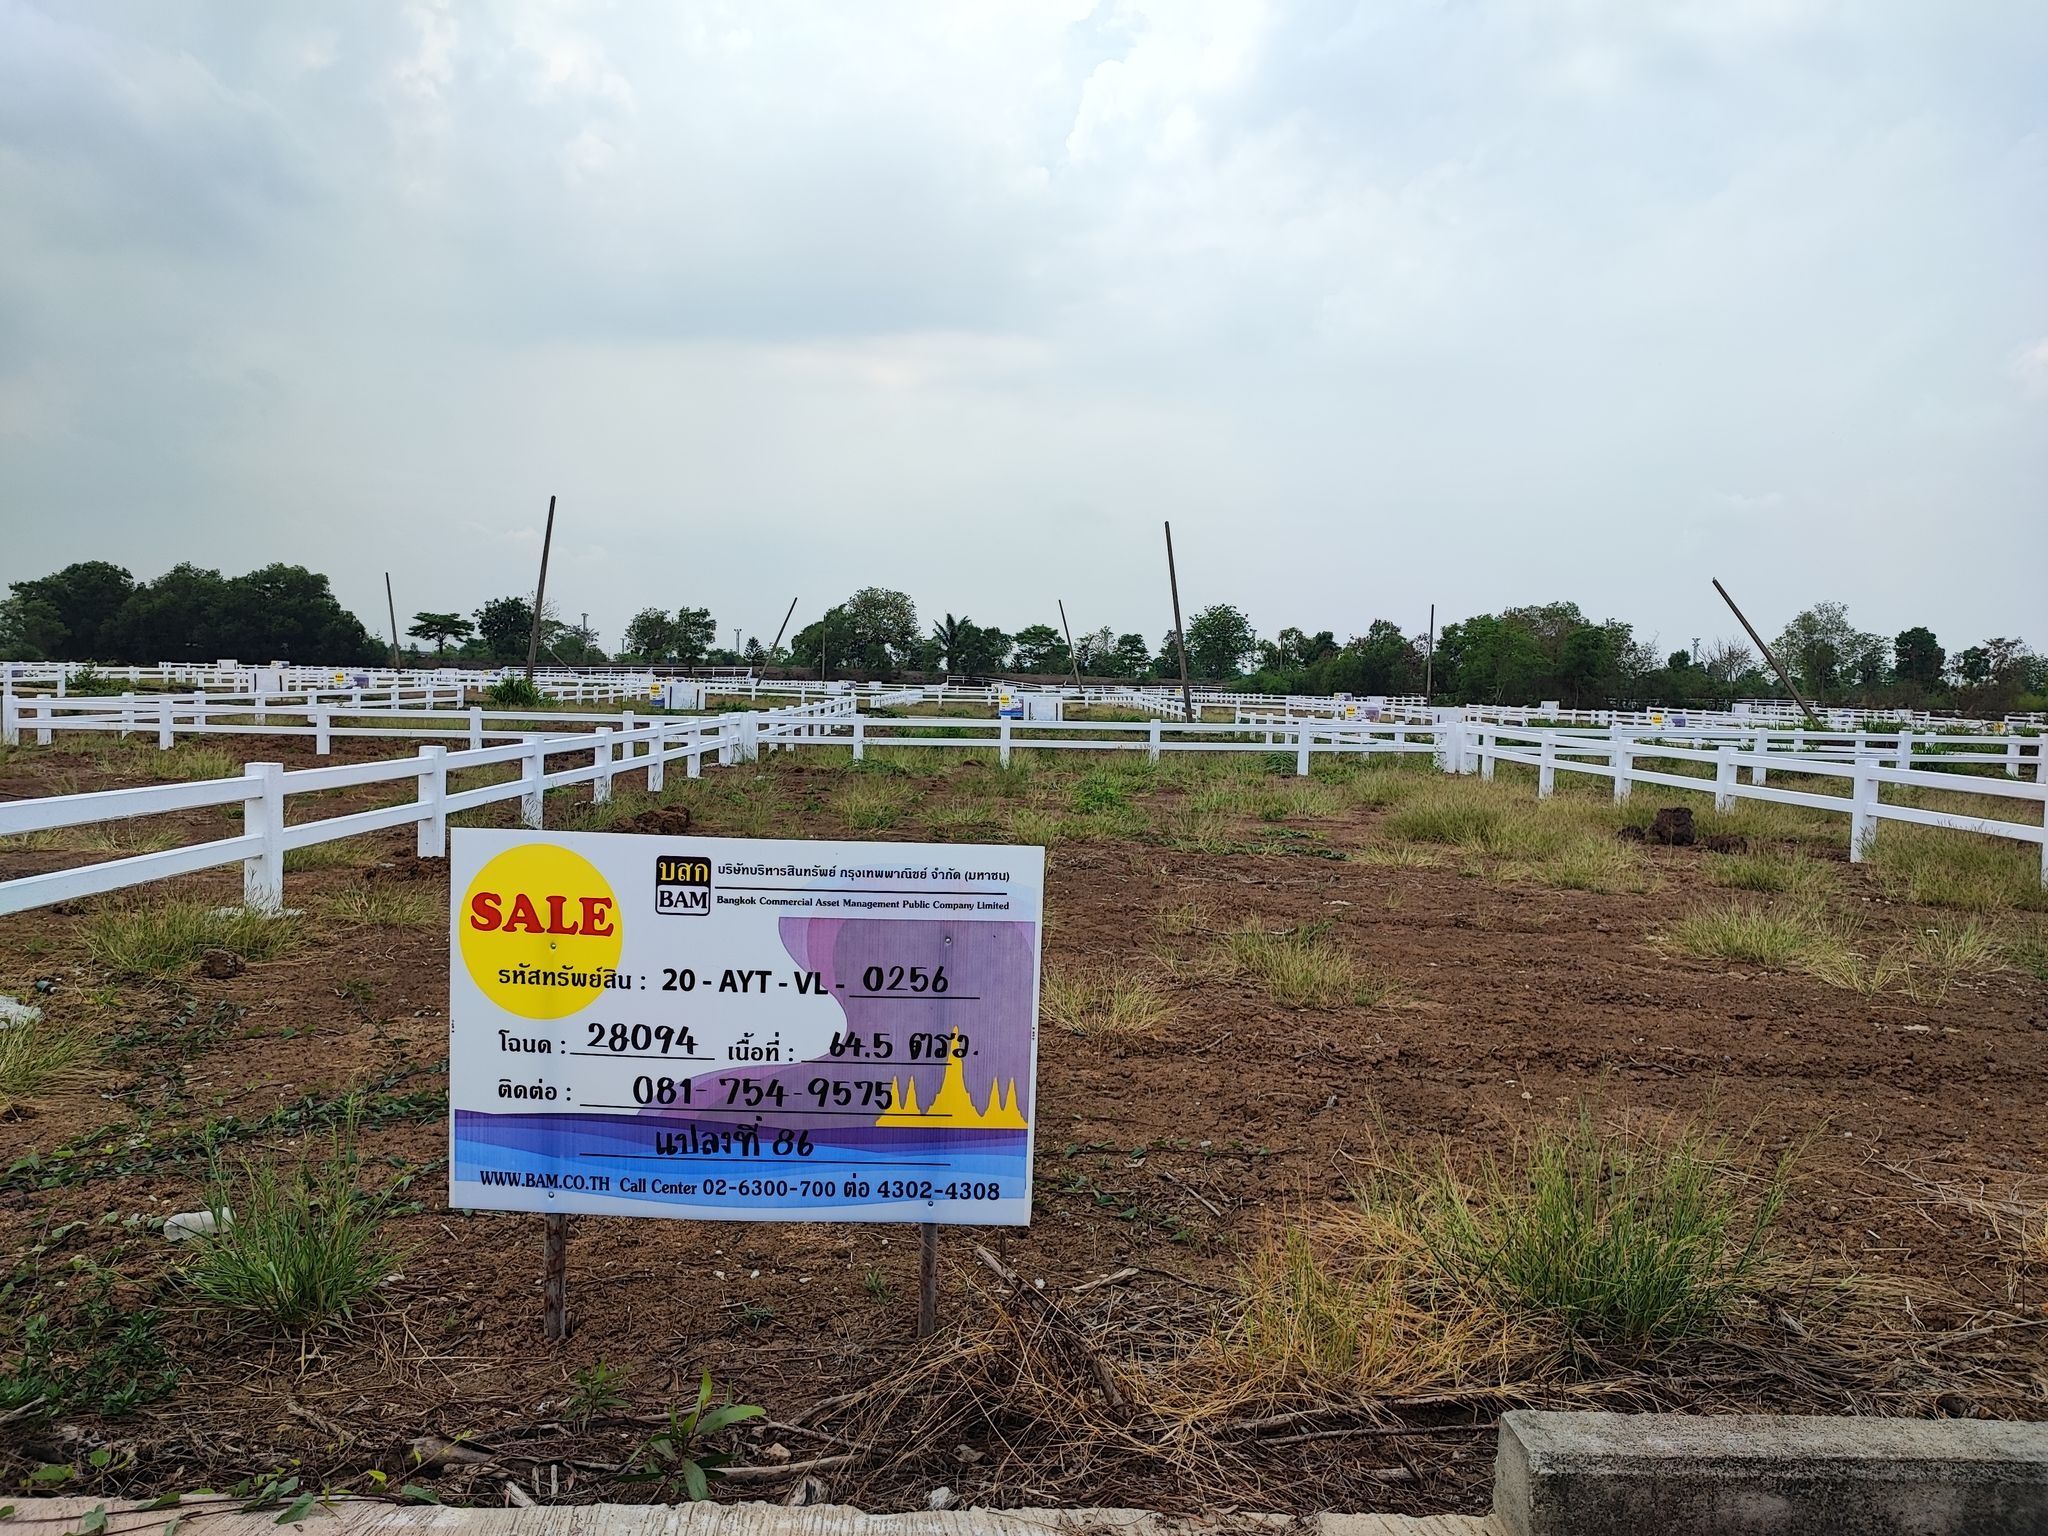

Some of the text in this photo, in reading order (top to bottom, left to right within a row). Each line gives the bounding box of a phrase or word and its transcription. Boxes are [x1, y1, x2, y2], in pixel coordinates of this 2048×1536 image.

[658, 861, 709, 883] บสก
[717, 863, 1010, 882] บริษัทบริหารสินทรัพย์ กรุงเทพพาณิชย์ จำกัด (มหาชน)
[658, 890, 708, 909] BAM
[716, 895, 1010, 911] Bangkok Commercial Asset Management Public Company Limited
[470, 891, 615, 937] SALE
[498, 962, 632, 990] รหัสทรัพย์สิน
[862, 966, 949, 993] 0256
[498, 1029, 552, 1054] โฉนด
[586, 1022, 699, 1056] 28094
[727, 1031, 780, 1062] เนื้อที่
[829, 1031, 894, 1059] 64.5
[498, 1078, 558, 1101] ติดต่อ
[771, 1128, 815, 1157] 86
[480, 1170, 1001, 1201] WWW.BAM.CO.TH Call Center 02-6300-700 ต่อ 4302-4308
